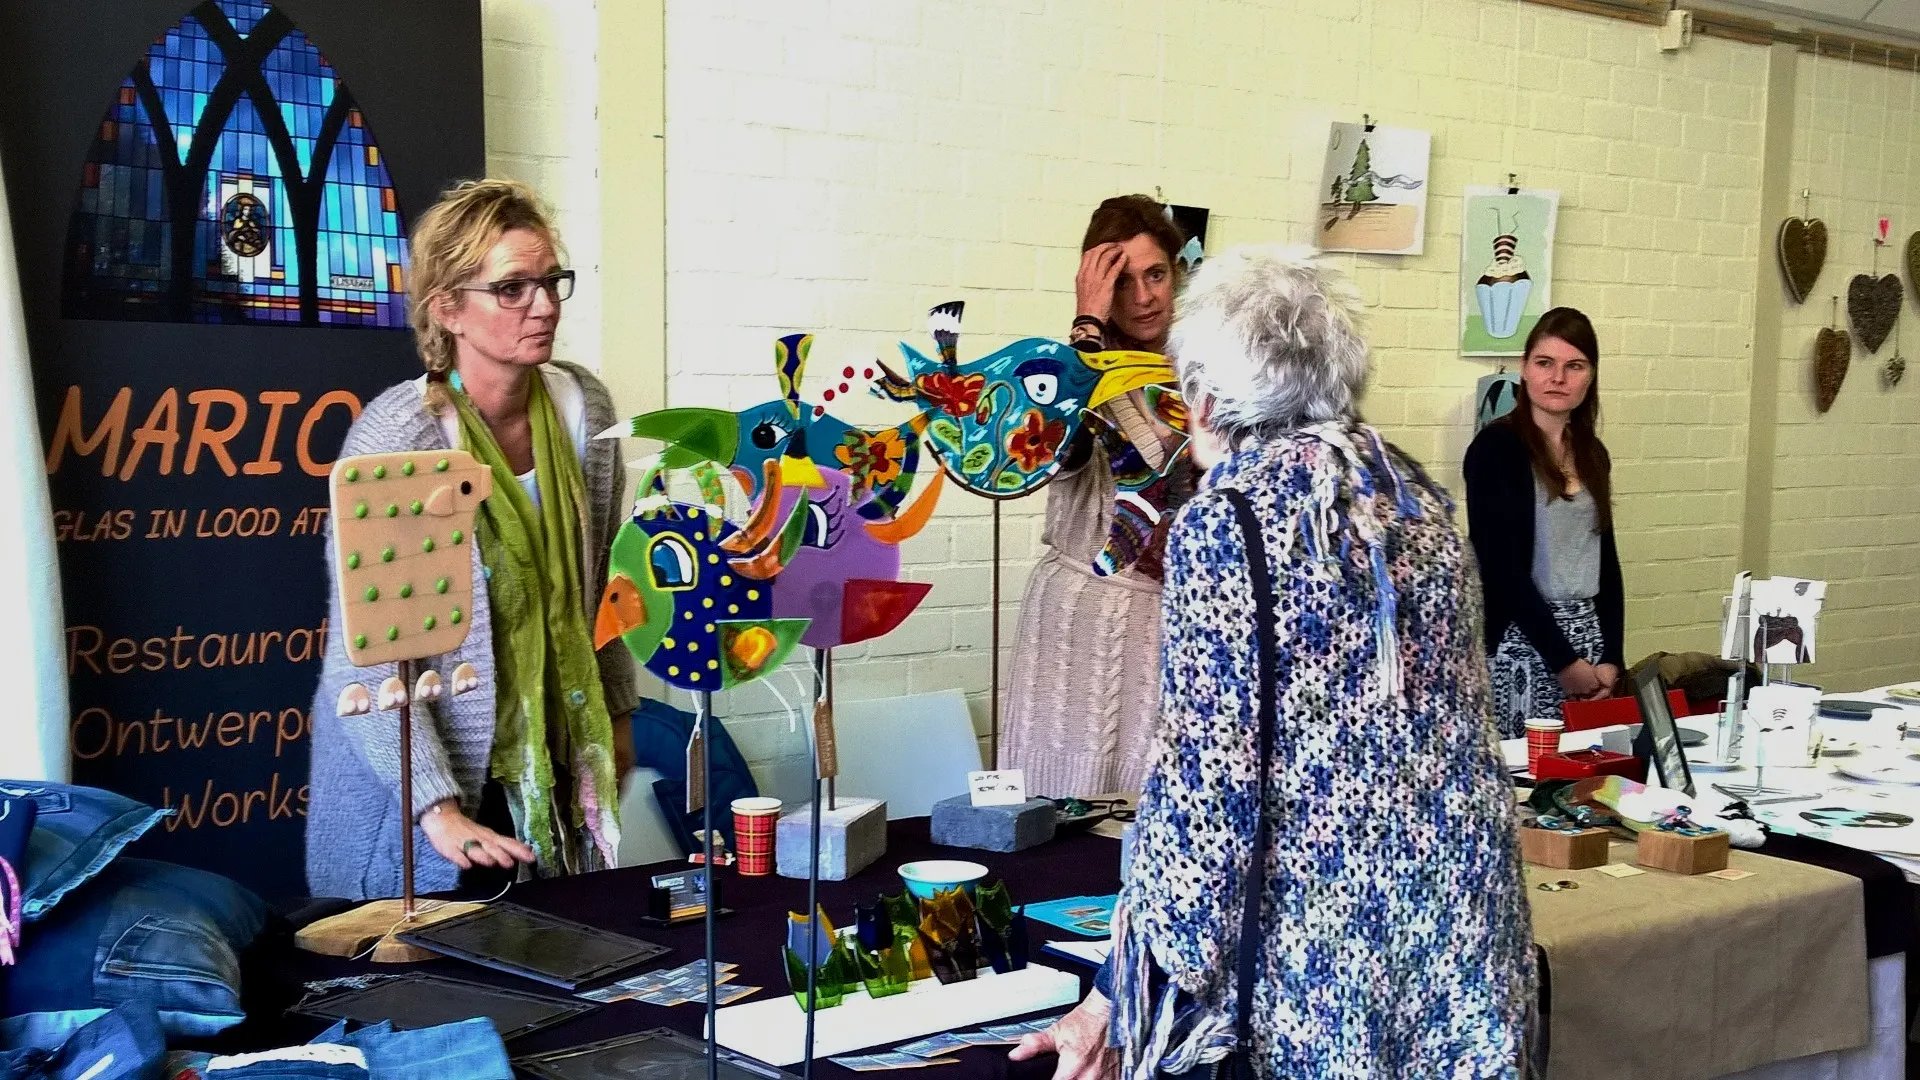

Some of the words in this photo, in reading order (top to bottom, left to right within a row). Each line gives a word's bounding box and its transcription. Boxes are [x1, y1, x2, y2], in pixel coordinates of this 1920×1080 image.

[46, 385, 362, 482] MARIO
[52, 509, 135, 542] GLAS
[144, 508, 187, 539] IN
[196, 507, 281, 538] LOOD
[71, 706, 314, 759] Ontwerp
